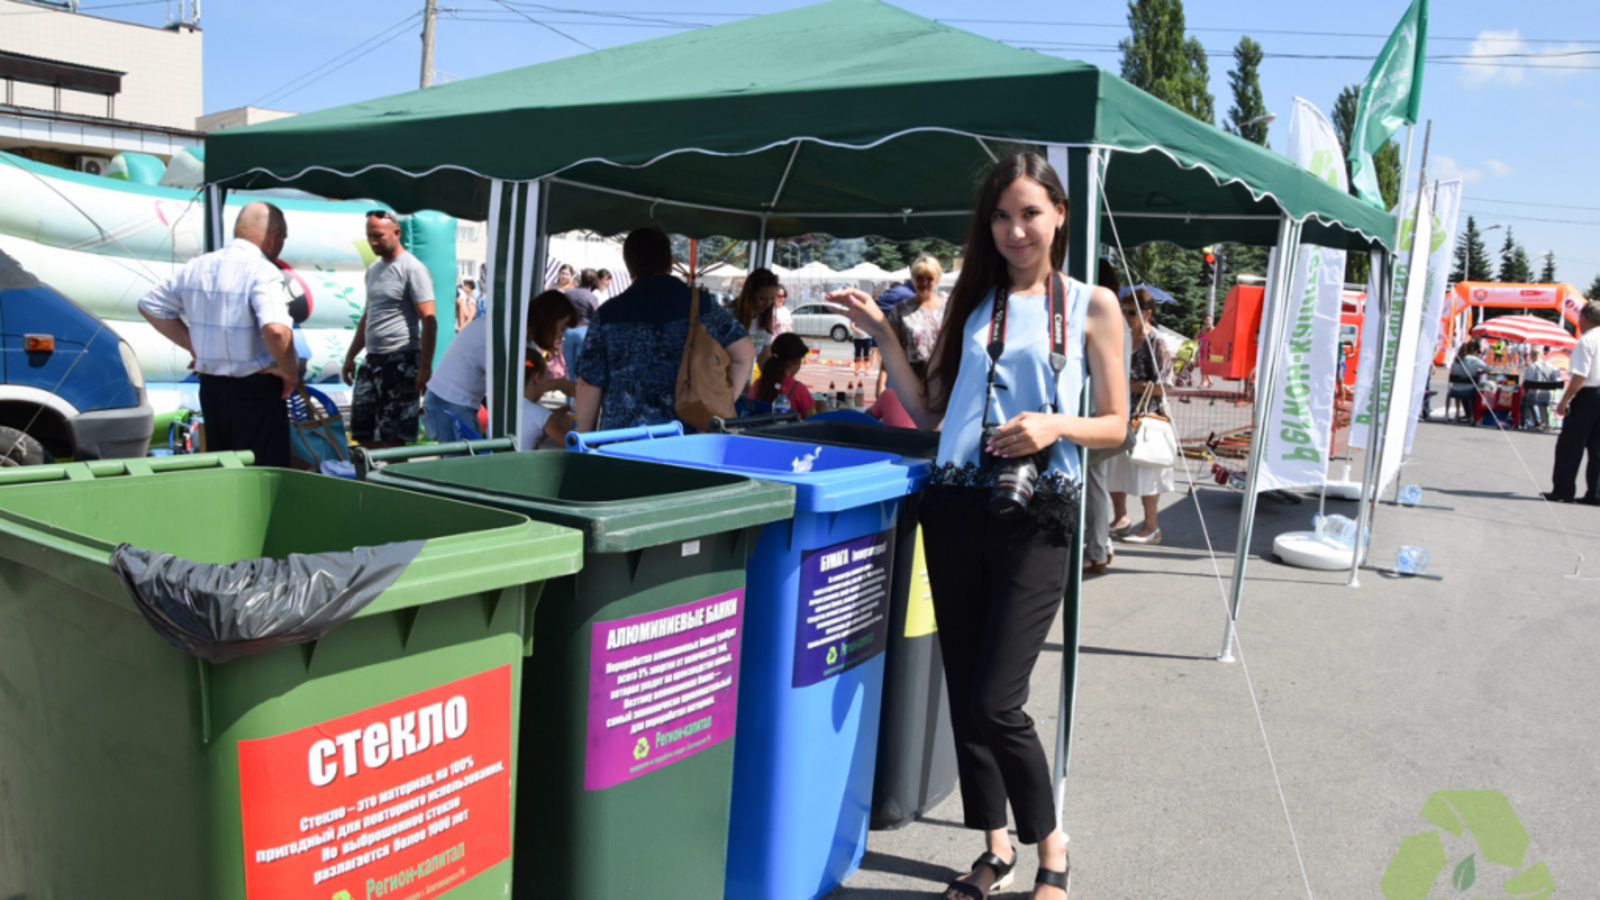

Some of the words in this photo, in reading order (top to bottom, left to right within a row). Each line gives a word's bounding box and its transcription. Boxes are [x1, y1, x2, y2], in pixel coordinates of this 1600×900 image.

[820, 548, 849, 572] БУМАГА
[606, 607, 704, 650] АЛЮМИНИЕВЫЕ
[705, 597, 738, 624] БАНКИ
[299, 806, 346, 832] Стекло
[356, 795, 377, 812] это
[378, 773, 434, 804] материал,
[435, 767, 449, 781] на
[450, 755, 474, 775] 100%
[256, 826, 335, 863] пригодный
[337, 819, 361, 840] для
[363, 794, 426, 828] повторного
[313, 844, 390, 885] разлагается
[393, 829, 426, 852] более
[427, 815, 450, 837] 1000
[452, 808, 469, 826] лет
[321, 846, 338, 862] Но
[342, 812, 424, 854] выброшенное
[425, 796, 460, 821] стекло
[366, 842, 464, 900] Регион-капитал
